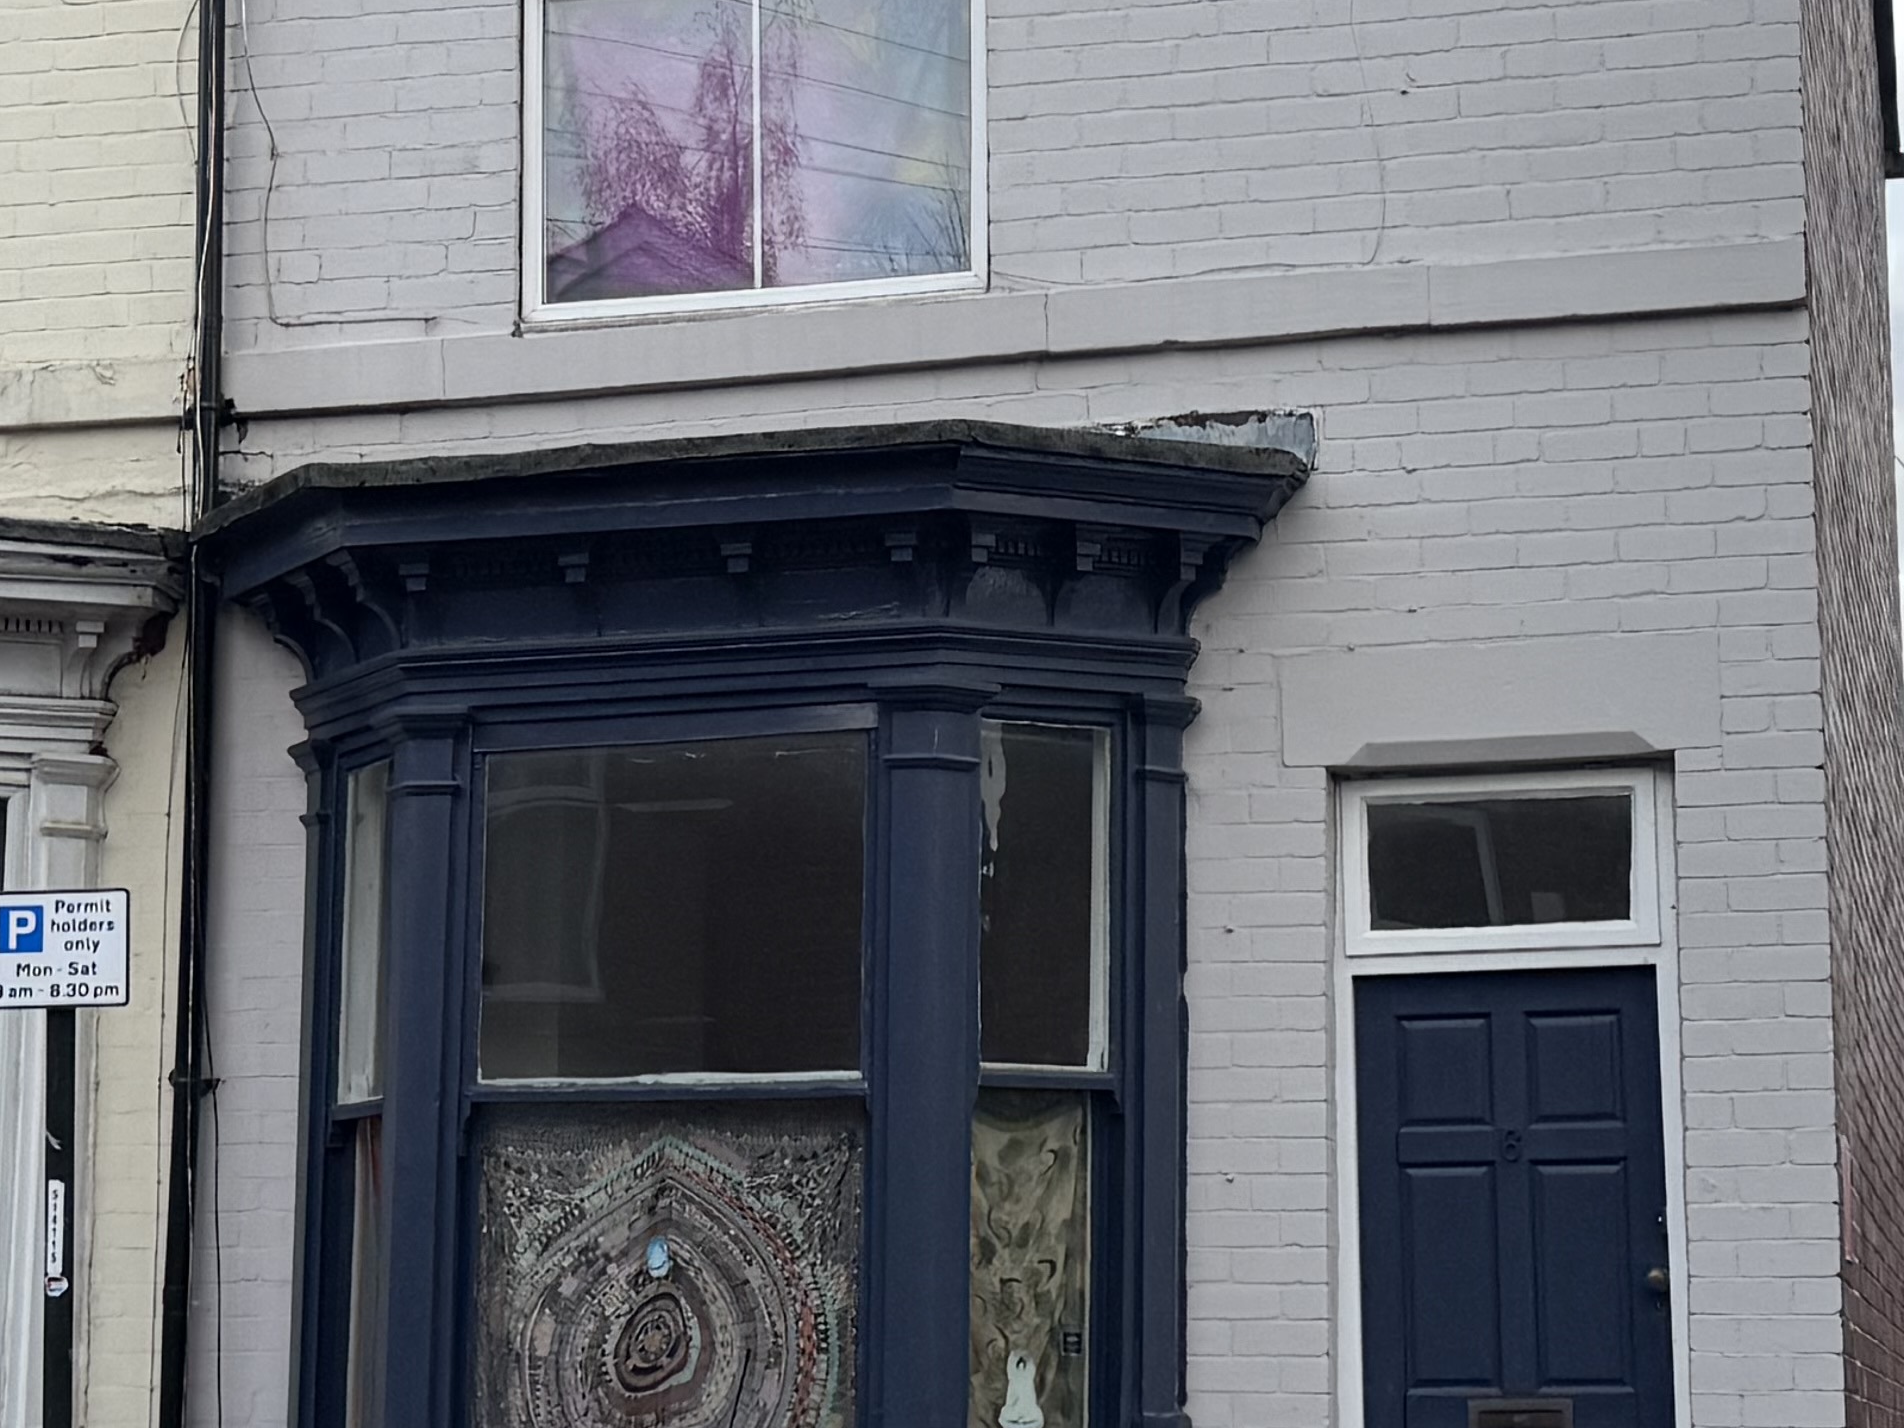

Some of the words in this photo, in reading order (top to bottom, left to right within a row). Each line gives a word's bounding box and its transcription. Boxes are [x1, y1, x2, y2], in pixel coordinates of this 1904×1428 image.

[55, 899, 111, 914] Permit
[8, 910, 36, 950] P
[50, 918, 115, 933] holders
[64, 937, 100, 954] only
[16, 963, 53, 977] Mon
[67, 961, 97, 976] Sat
[8, 987, 33, 998] am
[50, 983, 89, 998] 8.30
[93, 985, 119, 999] pm
